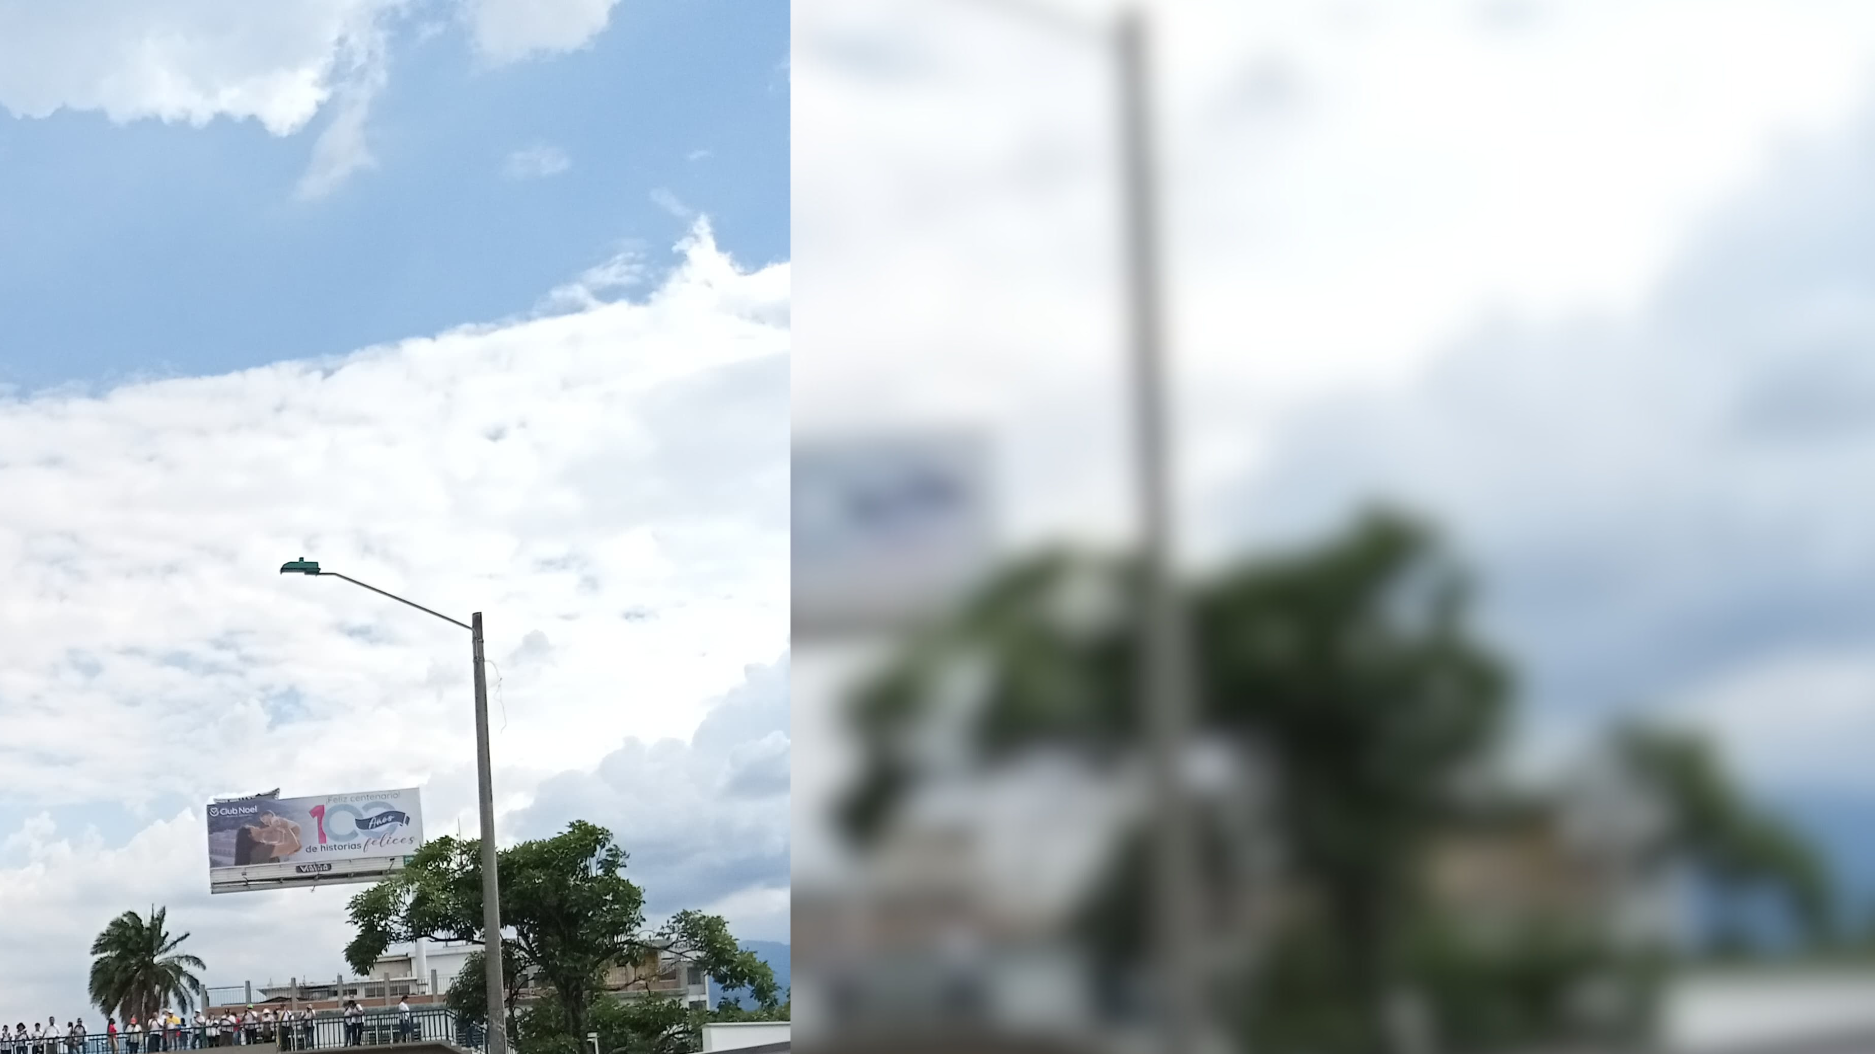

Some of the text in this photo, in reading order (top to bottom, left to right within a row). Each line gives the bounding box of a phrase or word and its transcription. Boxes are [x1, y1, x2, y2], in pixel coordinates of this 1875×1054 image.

[350, 791, 401, 803] centenario!
[220, 805, 258, 815] Club Noel
[305, 832, 416, 853] de historias felices
